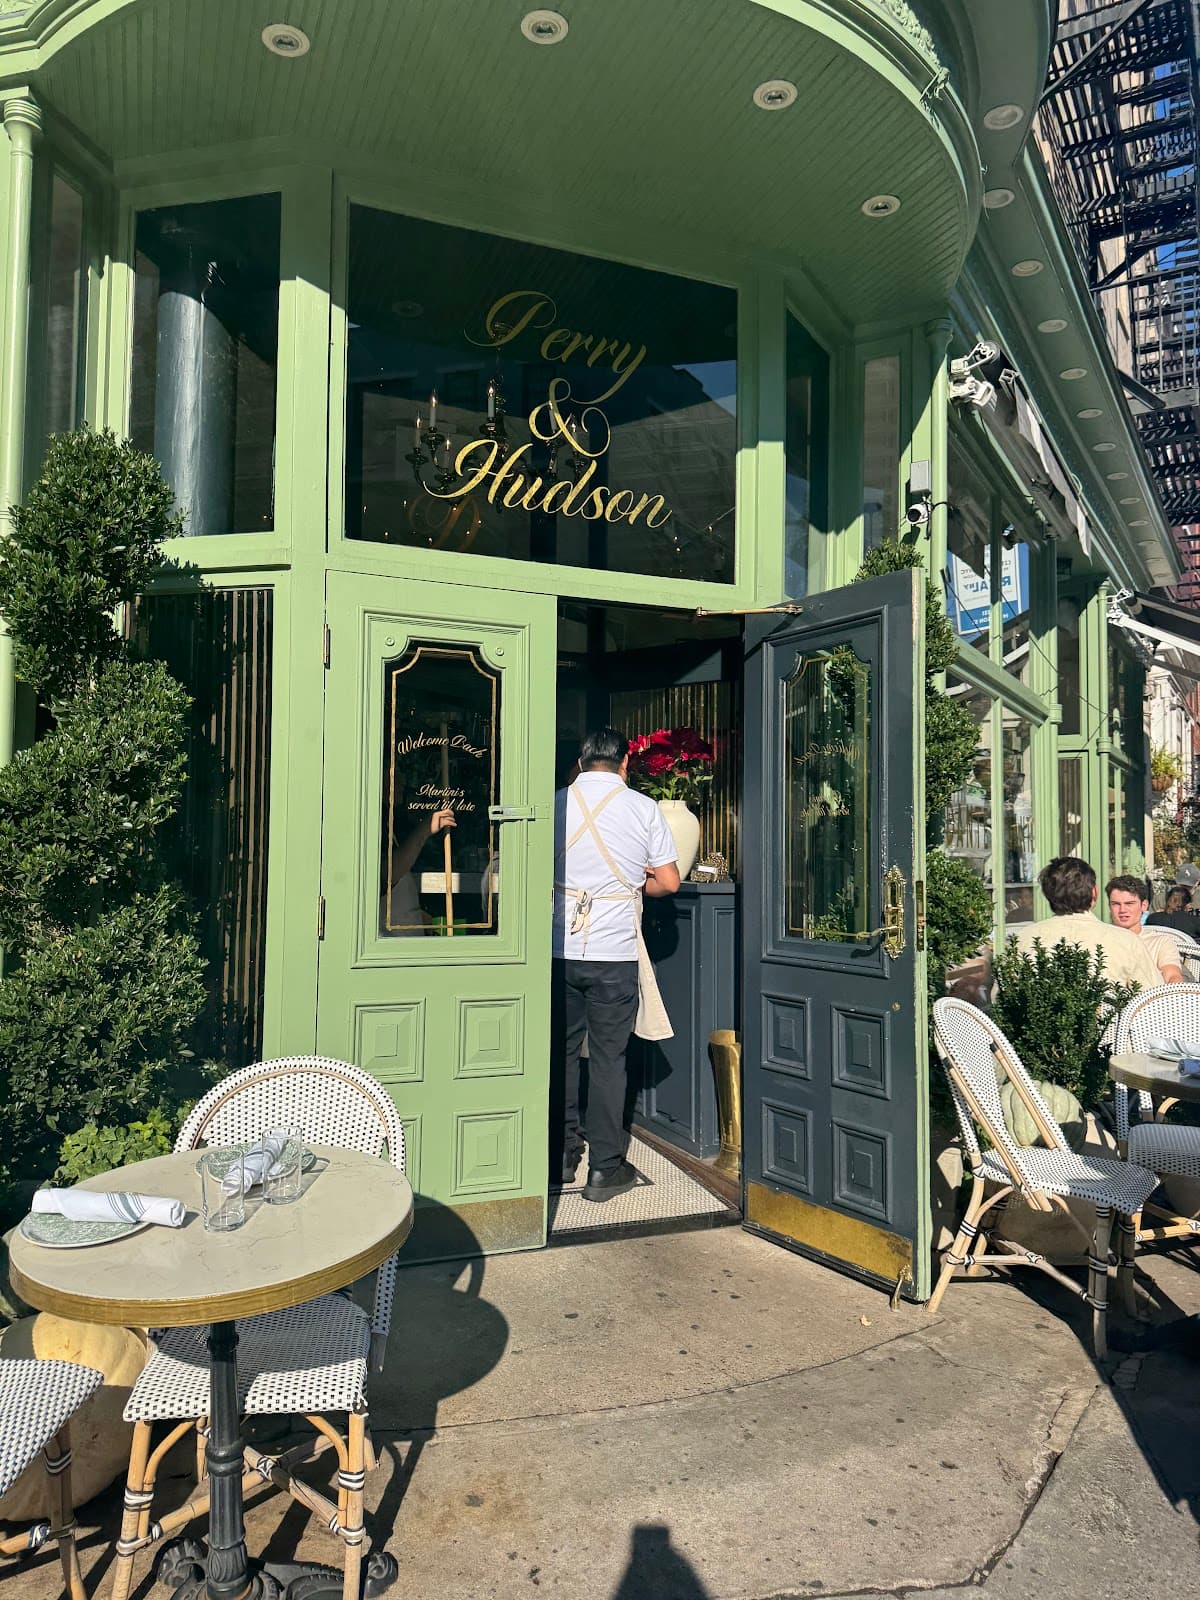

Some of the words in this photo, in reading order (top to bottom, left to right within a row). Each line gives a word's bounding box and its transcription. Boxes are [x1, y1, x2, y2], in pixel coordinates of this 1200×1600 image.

[463, 290, 648, 405] Perry
[528, 377, 612, 457] &
[422, 439, 673, 529] Hudson
[397, 731, 449, 755] Welcome
[450, 735, 488, 758] Back
[407, 799, 441, 811] served
[456, 798, 476, 812] late
